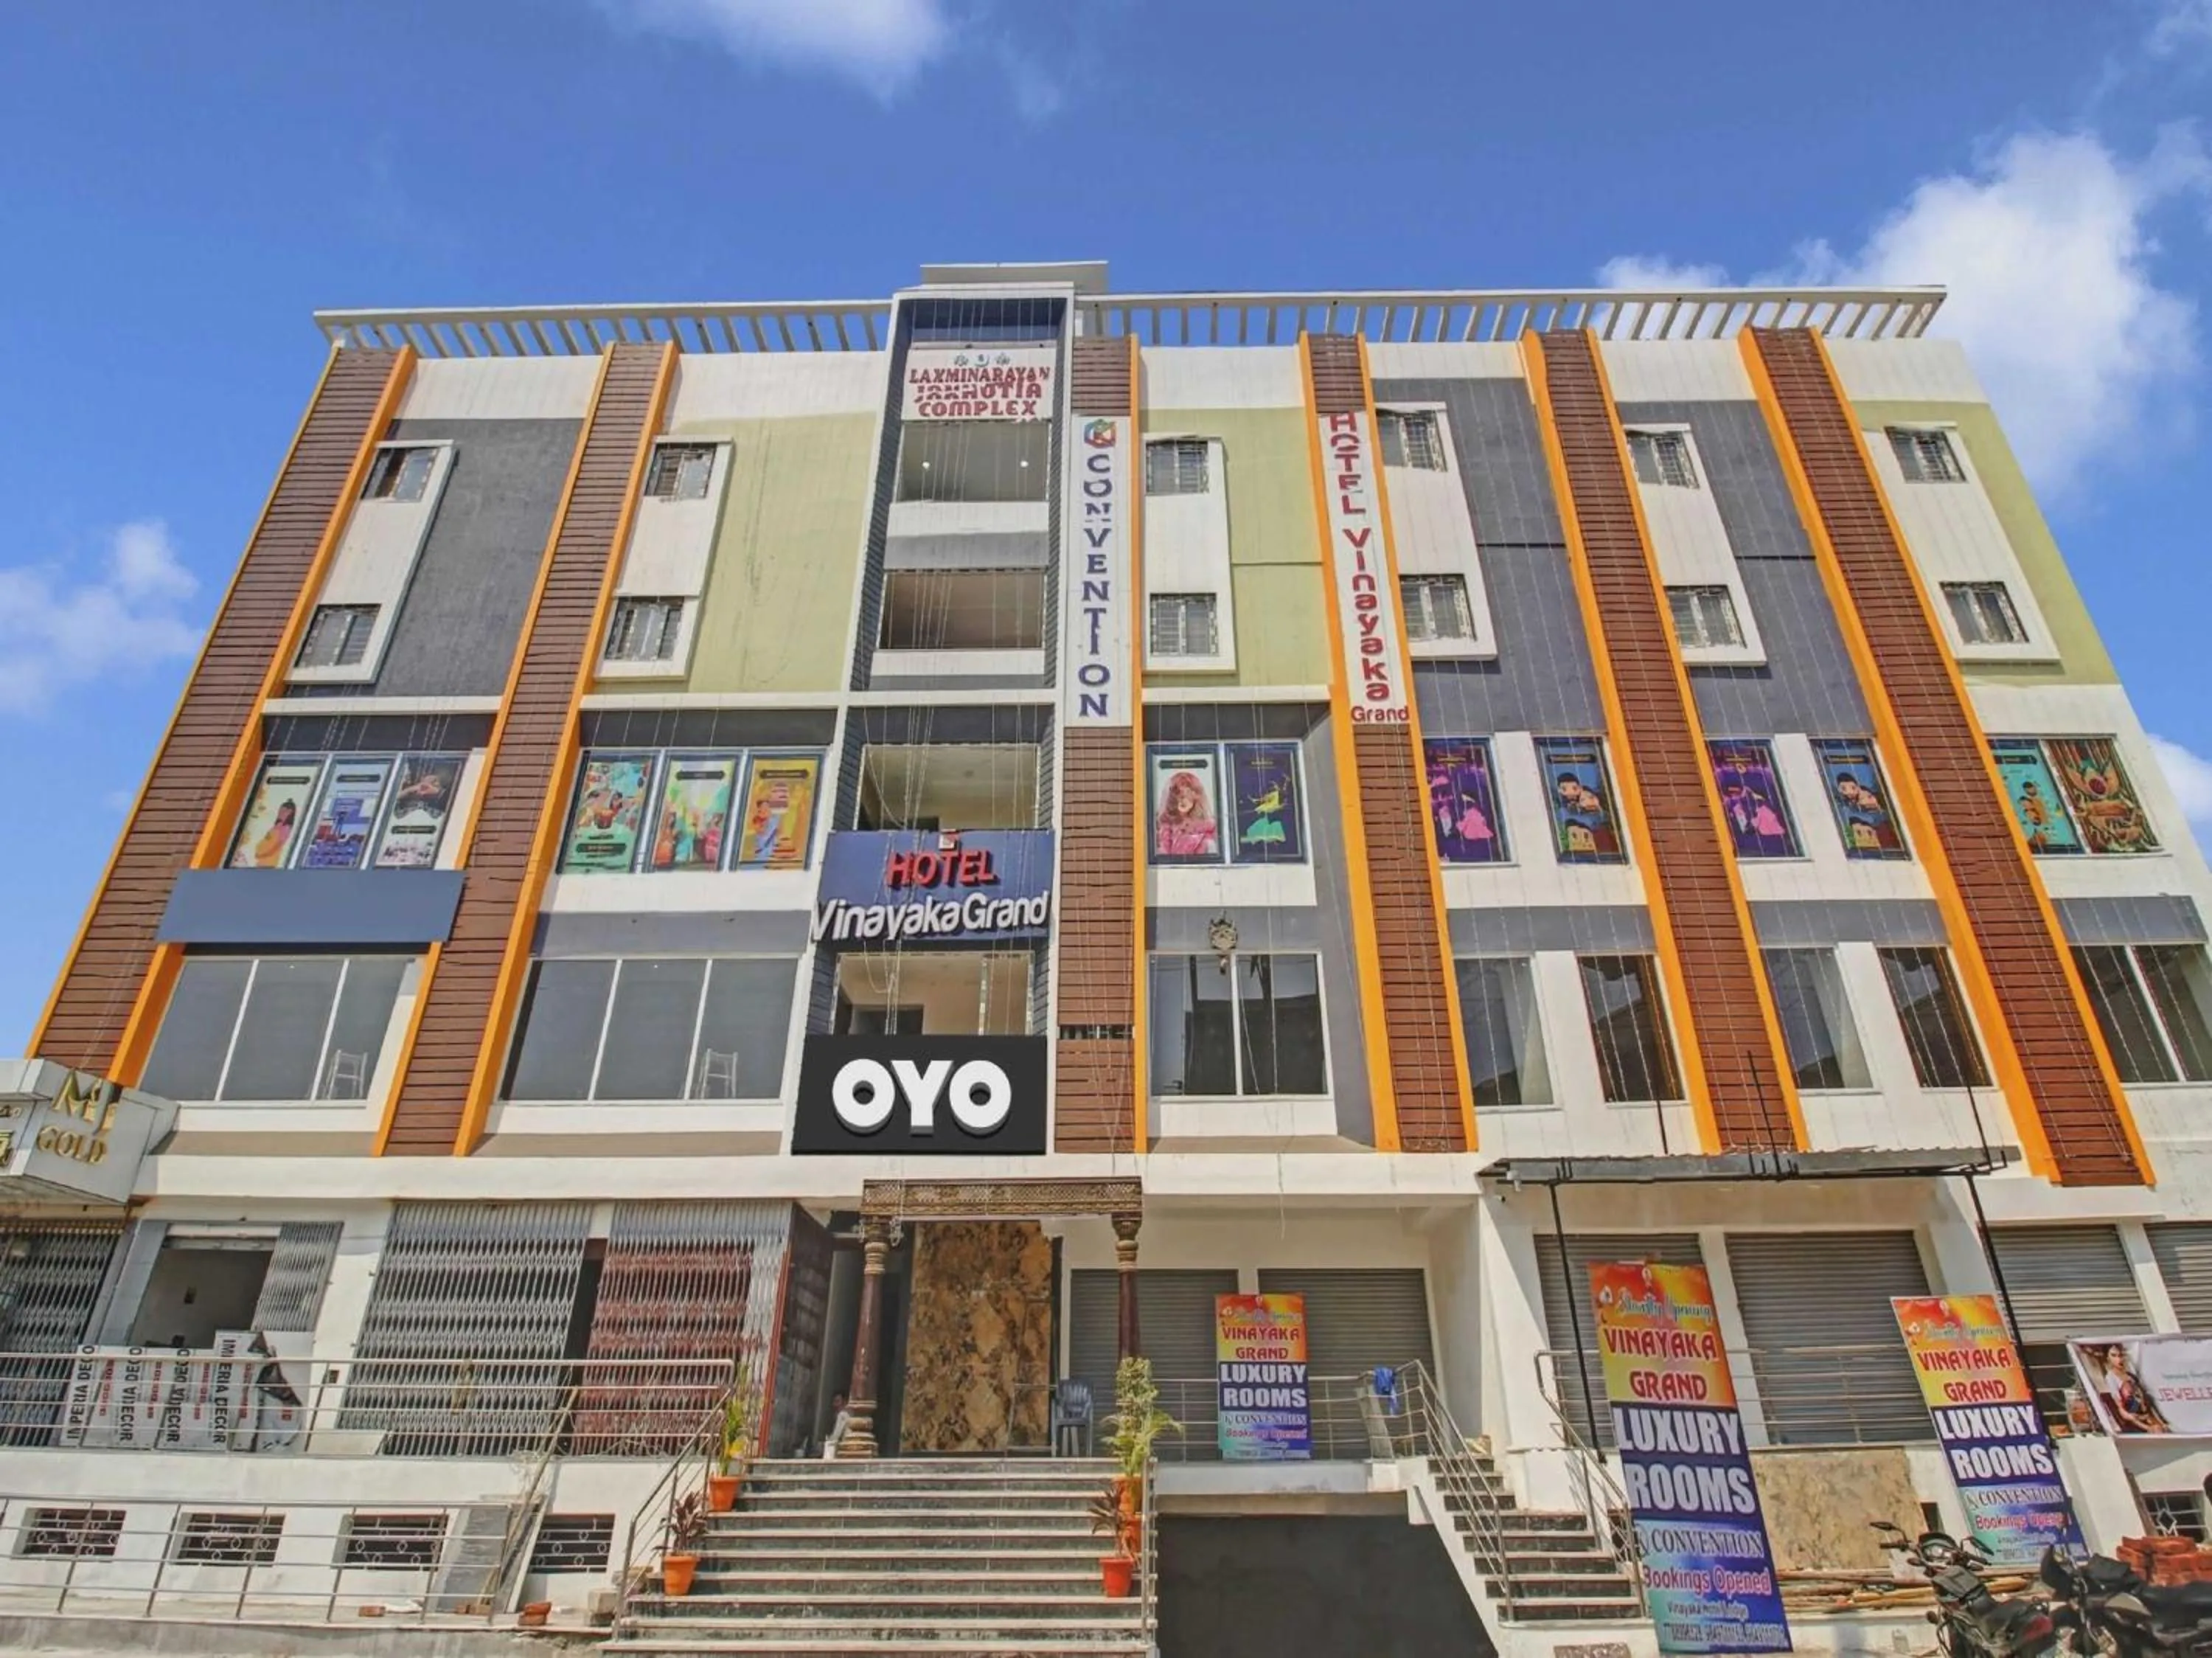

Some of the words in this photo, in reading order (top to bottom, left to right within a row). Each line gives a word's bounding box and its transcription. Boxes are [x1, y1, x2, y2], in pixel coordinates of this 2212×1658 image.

[909, 366, 1051, 384] LAXMINARAYAN
[919, 400, 1037, 417] COMPLEX
[1329, 411, 1366, 515] HOTEL
[1078, 454, 1112, 717] CONVENTION
[1351, 704, 1410, 724] Grand
[886, 849, 998, 887] HOTEL
[832, 1058, 1012, 1136] OYO
[36, 1125, 108, 1165] GOLD
[1222, 1328, 1301, 1341] VINAYAKA
[1604, 1328, 1718, 1360] VINAYAKA
[215, 1339, 237, 1393] IMERIA
[1236, 1347, 1289, 1360] GRAND
[1917, 1347, 2011, 1371] VINAYAKA
[1220, 1364, 1307, 1384] LUXURY
[1630, 1371, 1708, 1401] GRAND
[1223, 1388, 1307, 1407] ROOMS
[1944, 1380, 2007, 1402] GRAND
[1613, 1407, 1741, 1454] LUXURY
[1935, 1405, 2039, 1439] LUXURY
[1950, 1443, 2053, 1480] ROOMS
[1624, 1463, 1756, 1513] ROOMS
[1652, 1529, 1764, 1558] CONVENTION
[1643, 1565, 1711, 1596] Bookings
[1714, 1566, 1771, 1599] Opened
